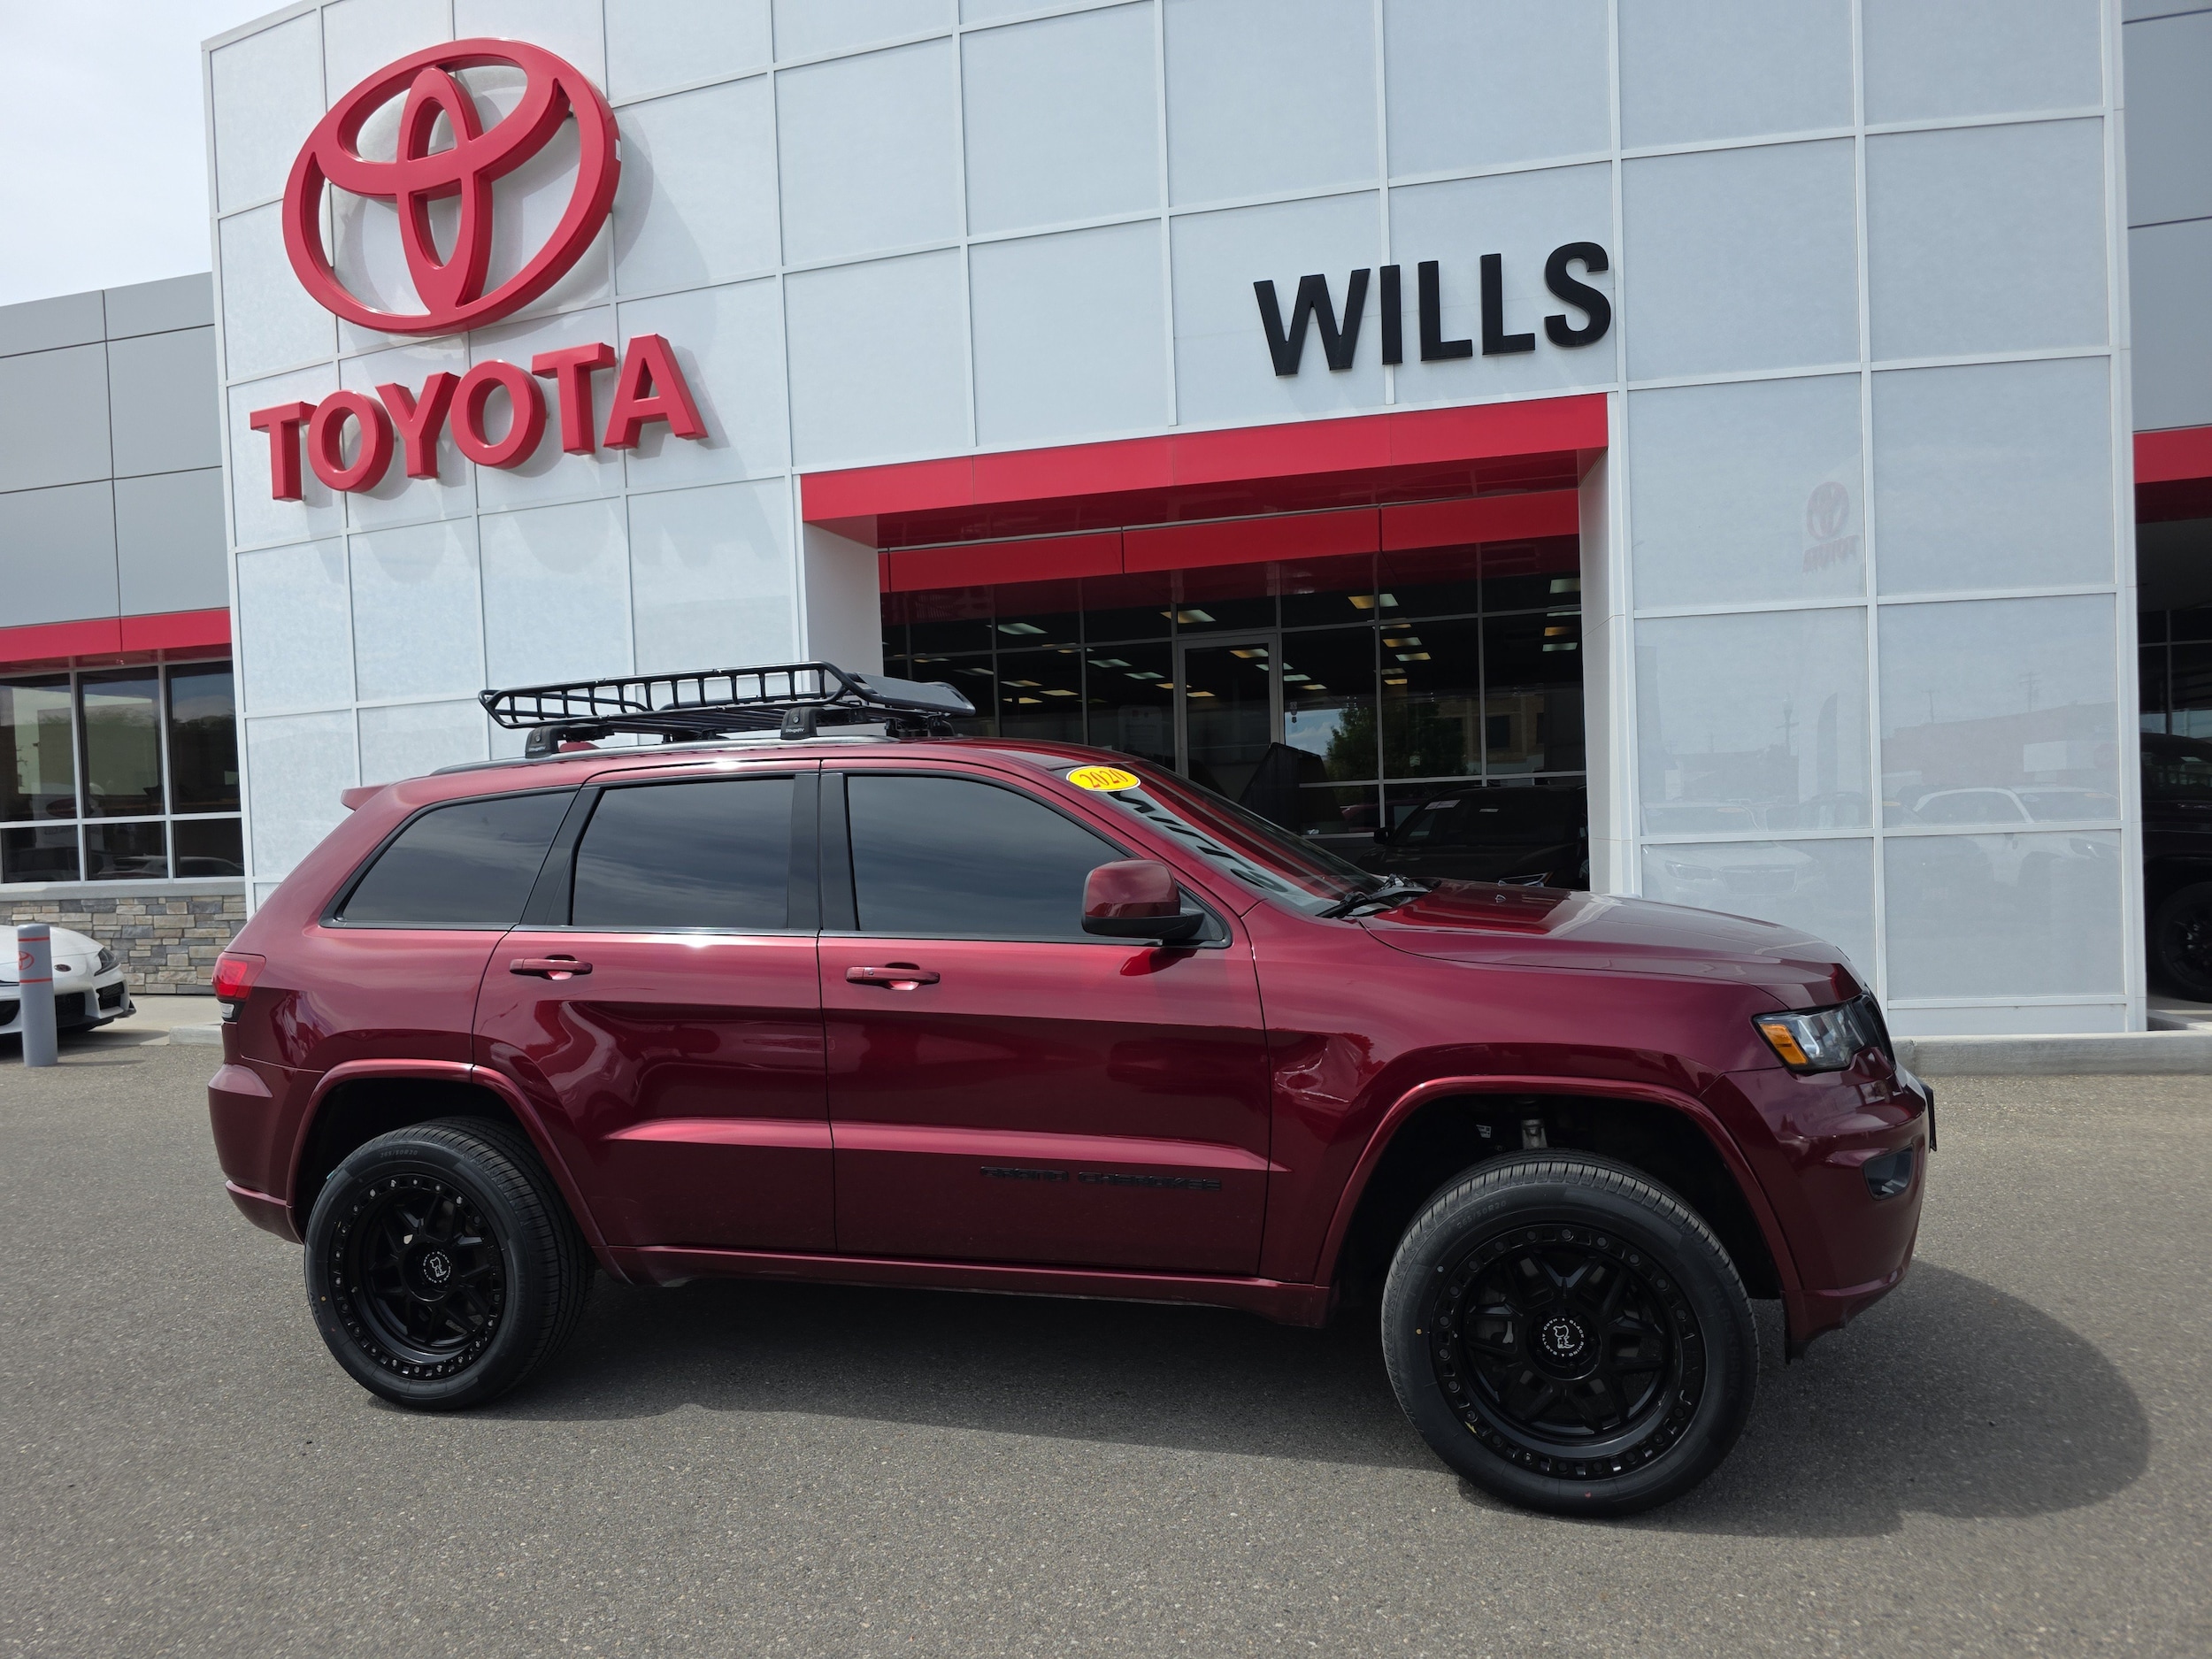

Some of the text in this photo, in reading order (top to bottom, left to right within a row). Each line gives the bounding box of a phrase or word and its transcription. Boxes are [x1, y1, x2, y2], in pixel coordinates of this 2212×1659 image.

[1253, 241, 1612, 377] WILLS
[250, 333, 708, 503] TOYOTA
[1079, 769, 1129, 788] 2020
[980, 1165, 1222, 1191] GRAND CHEROKEE
[1456, 1199, 1508, 1230] 265/50R20
[1569, 1319, 1584, 1339] BLACK
